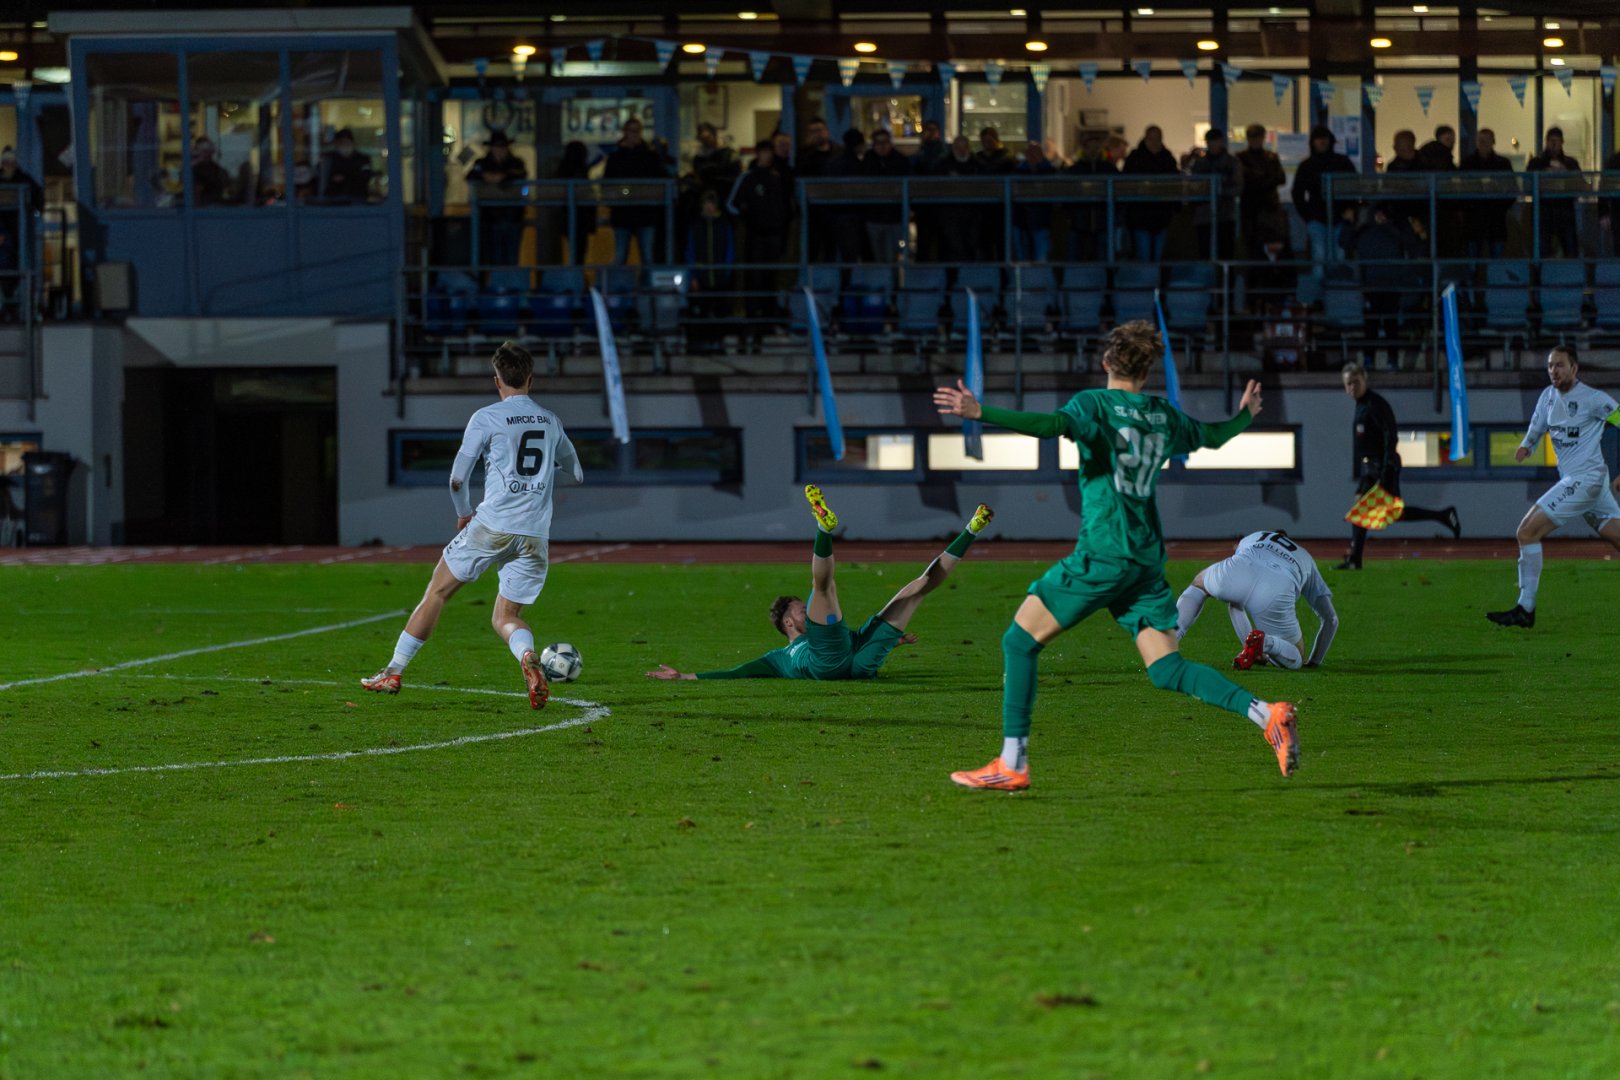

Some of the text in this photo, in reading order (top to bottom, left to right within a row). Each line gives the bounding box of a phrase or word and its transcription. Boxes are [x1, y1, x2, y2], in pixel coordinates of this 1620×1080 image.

[506, 416, 535, 425] MIRCIC
[516, 430, 545, 476] 6
[1113, 427, 1167, 498] 20
